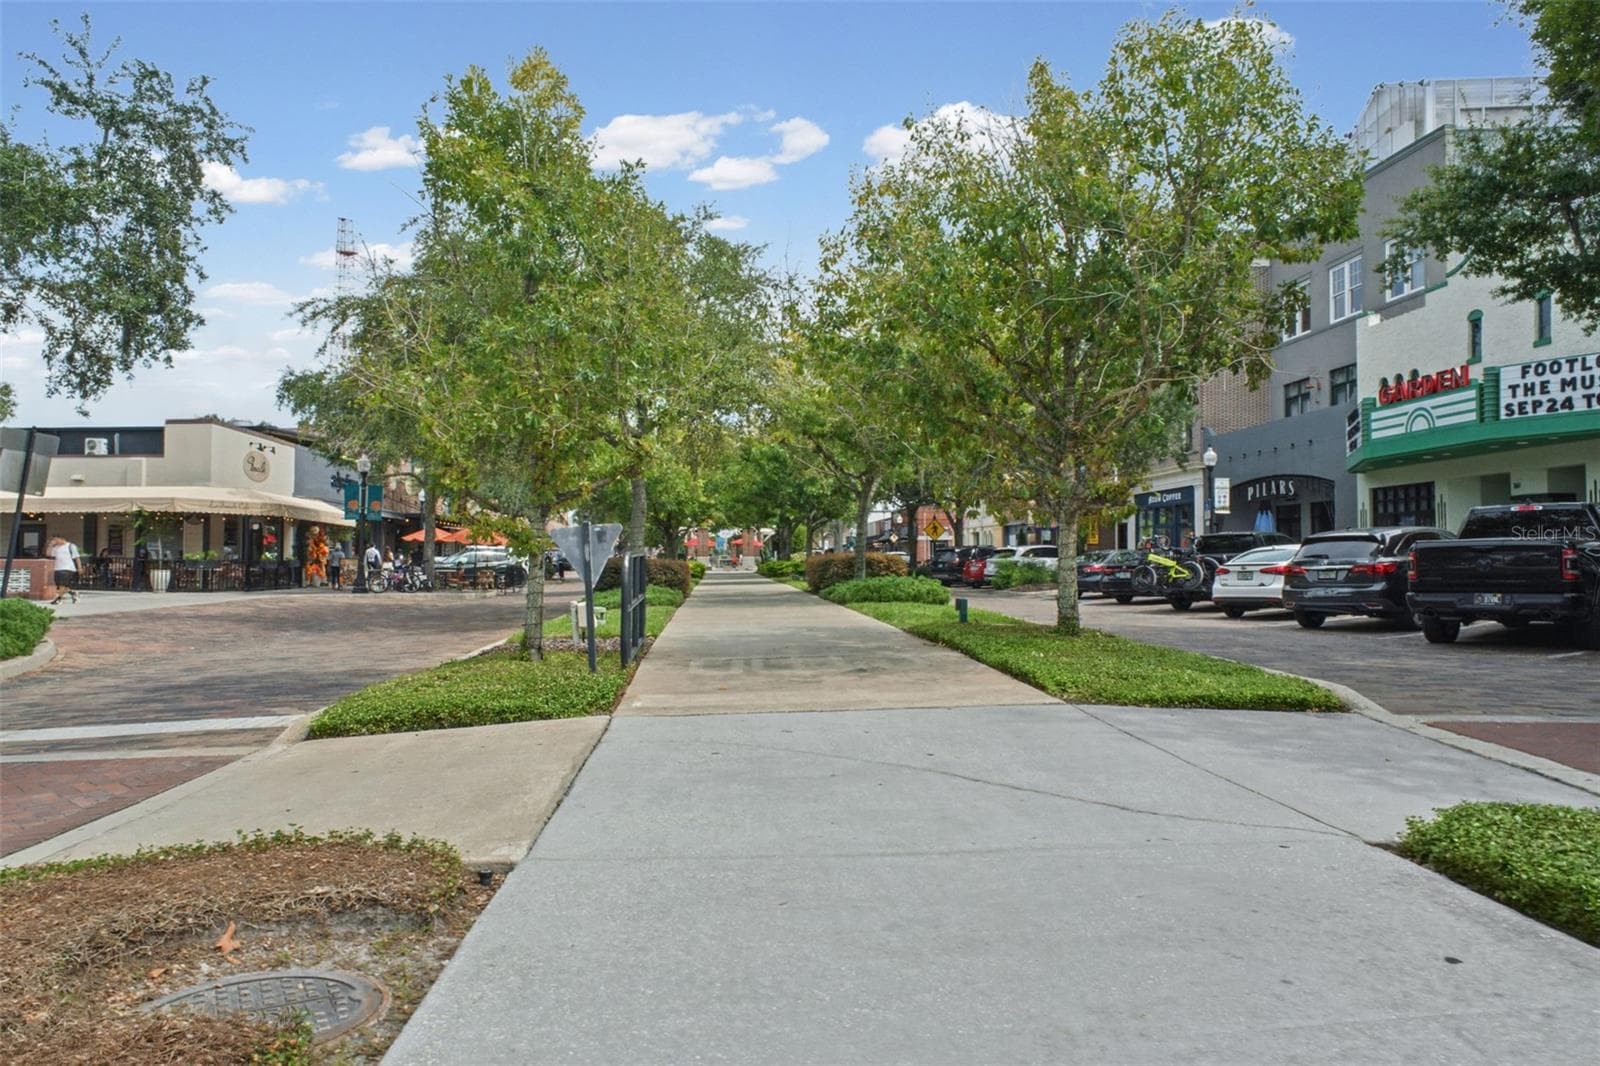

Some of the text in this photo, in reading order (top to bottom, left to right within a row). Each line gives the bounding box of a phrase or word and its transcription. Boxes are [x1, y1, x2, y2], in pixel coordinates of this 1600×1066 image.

[1379, 365, 1469, 405] GARDEN
[1508, 374, 1600, 399] THE MU
[1248, 480, 1294, 501] PILARS
